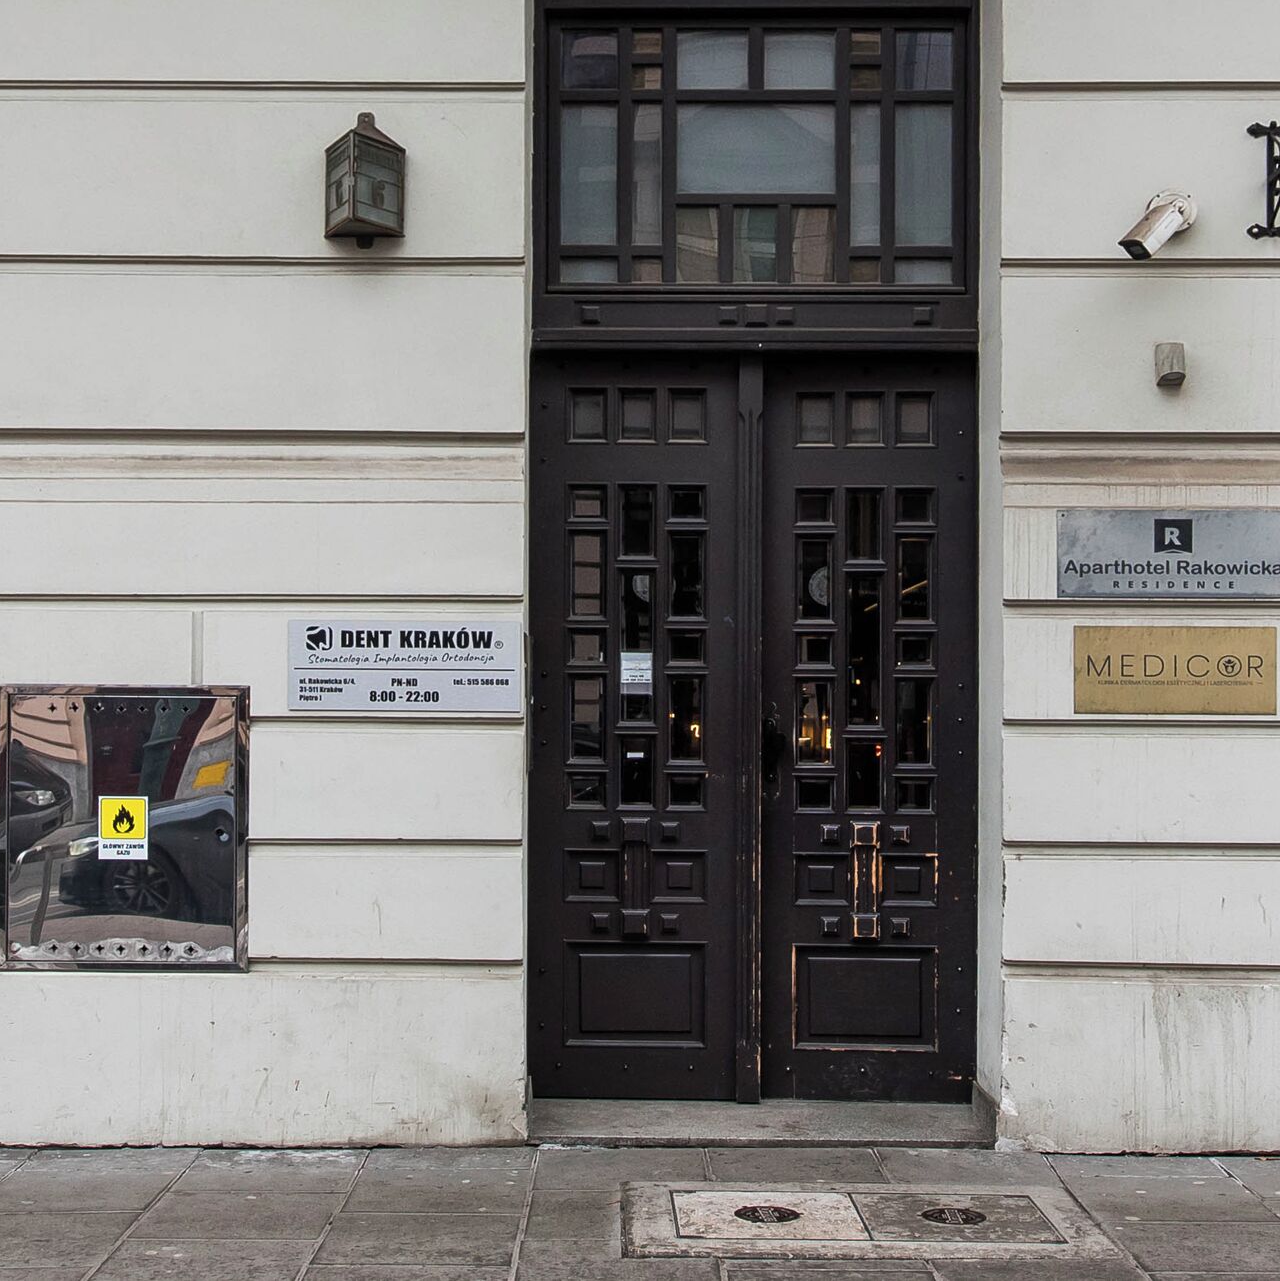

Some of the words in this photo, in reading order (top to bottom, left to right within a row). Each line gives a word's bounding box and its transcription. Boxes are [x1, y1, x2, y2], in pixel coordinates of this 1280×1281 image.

[1164, 528, 1180, 545] R
[1064, 560, 1170, 577] Aparthotel
[1113, 581, 1235, 589] RESIDENCE
[341, 630, 392, 648] DENT
[400, 628, 493, 649] KRAKÓW
[308, 654, 369, 665] Stomatologia
[373, 654, 438, 665] Implantologia
[442, 653, 495, 664] Ortodoncja
[1087, 654, 1264, 678] MEDICOR
[391, 678, 418, 687] PN-ND
[369, 691, 396, 702] 8:00
[406, 691, 439, 702] 22:00
